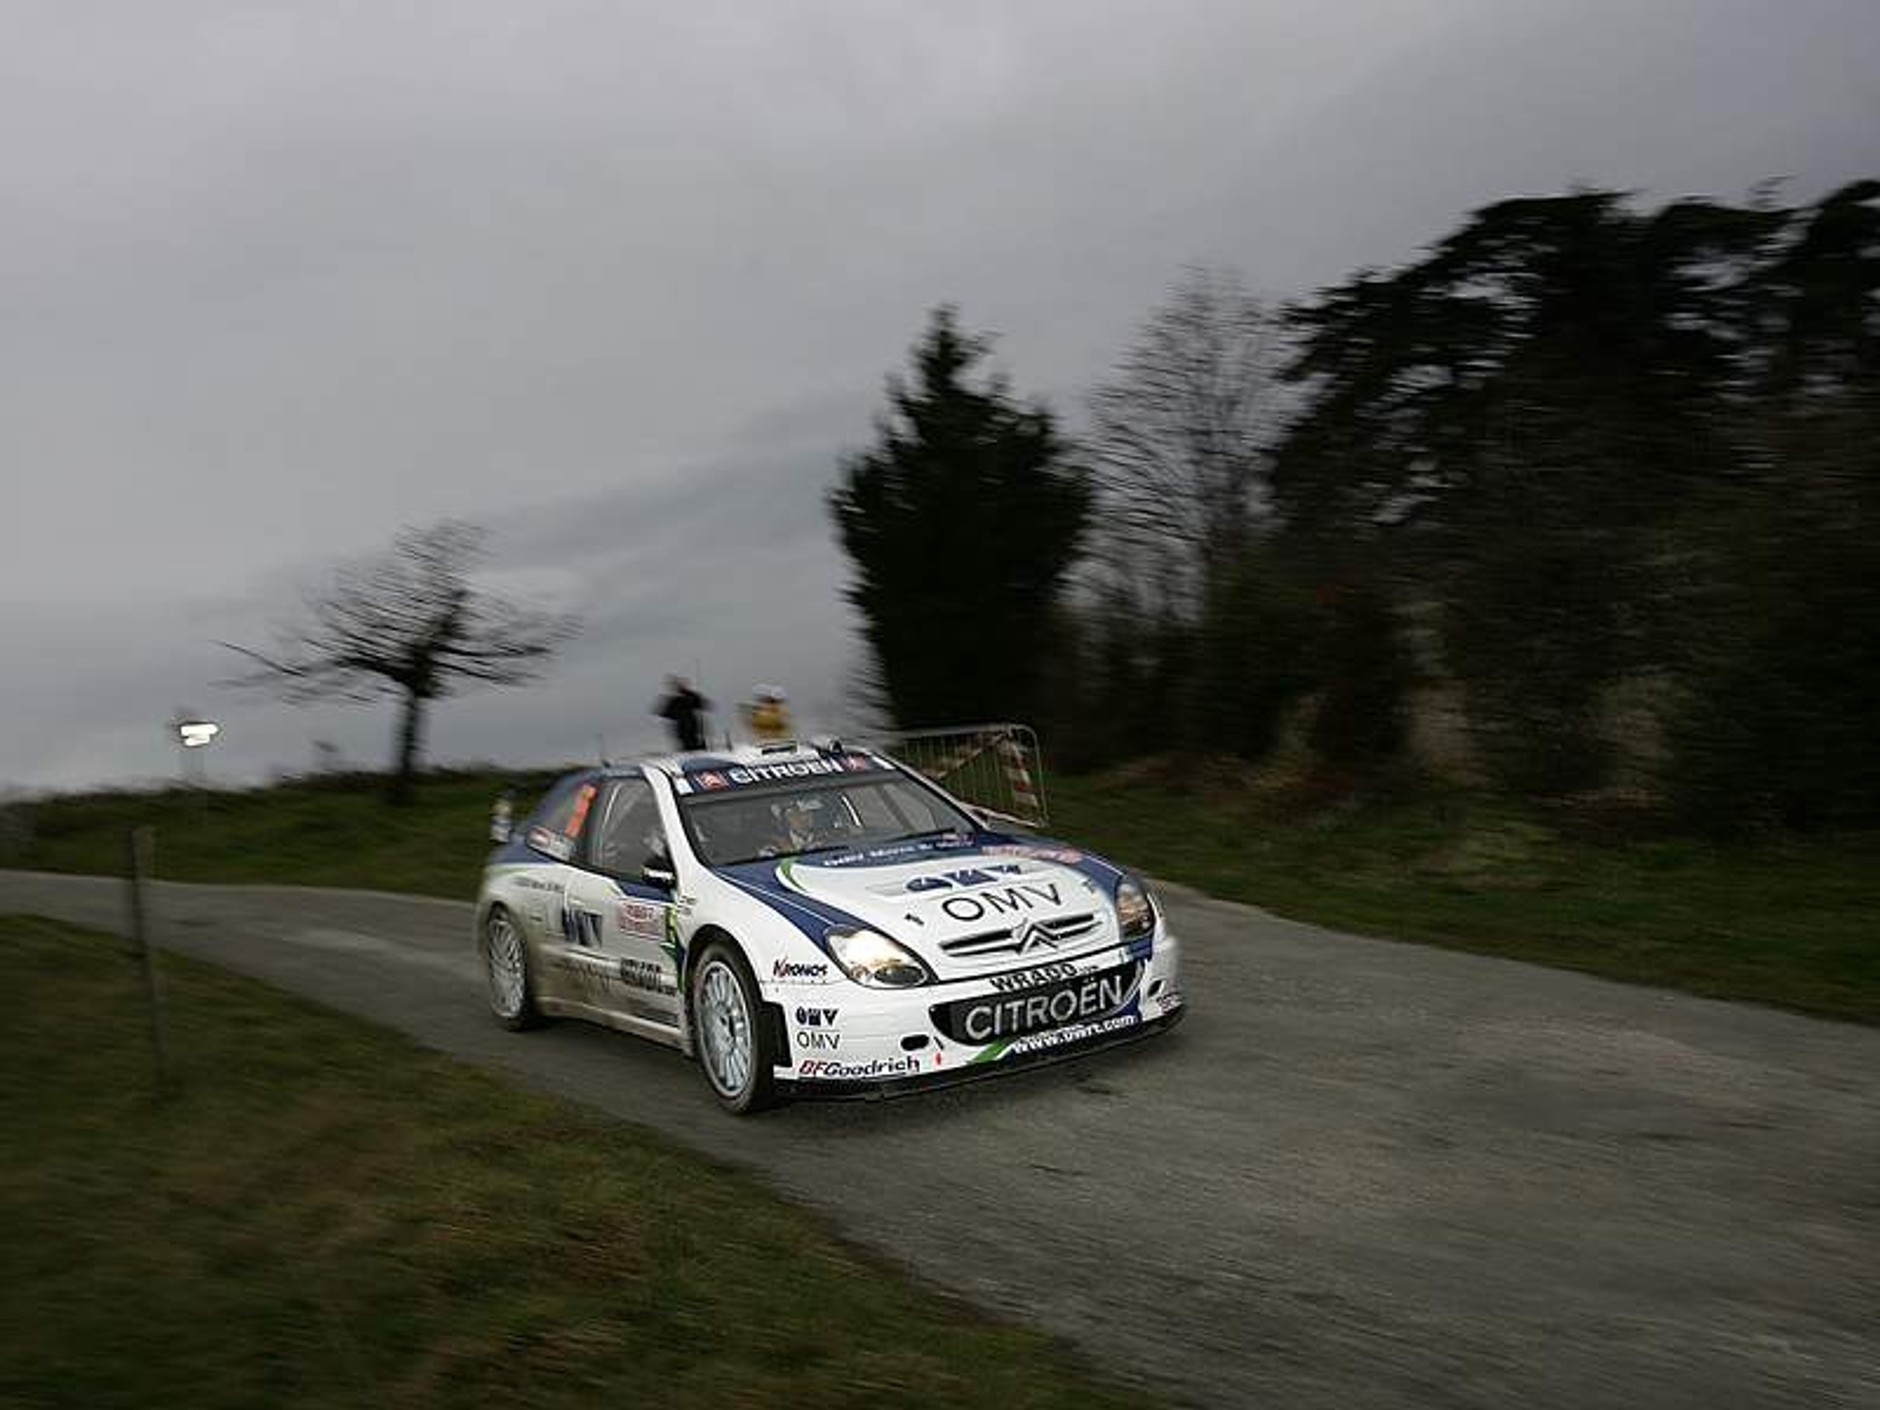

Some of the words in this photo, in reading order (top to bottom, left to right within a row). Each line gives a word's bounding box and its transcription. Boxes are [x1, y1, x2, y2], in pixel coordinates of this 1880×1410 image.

[942, 882, 1063, 921] OMV
[965, 971, 1123, 1040] CITROËN
[796, 1031, 841, 1050] OMV
[799, 1055, 922, 1077] BFGoodrich
